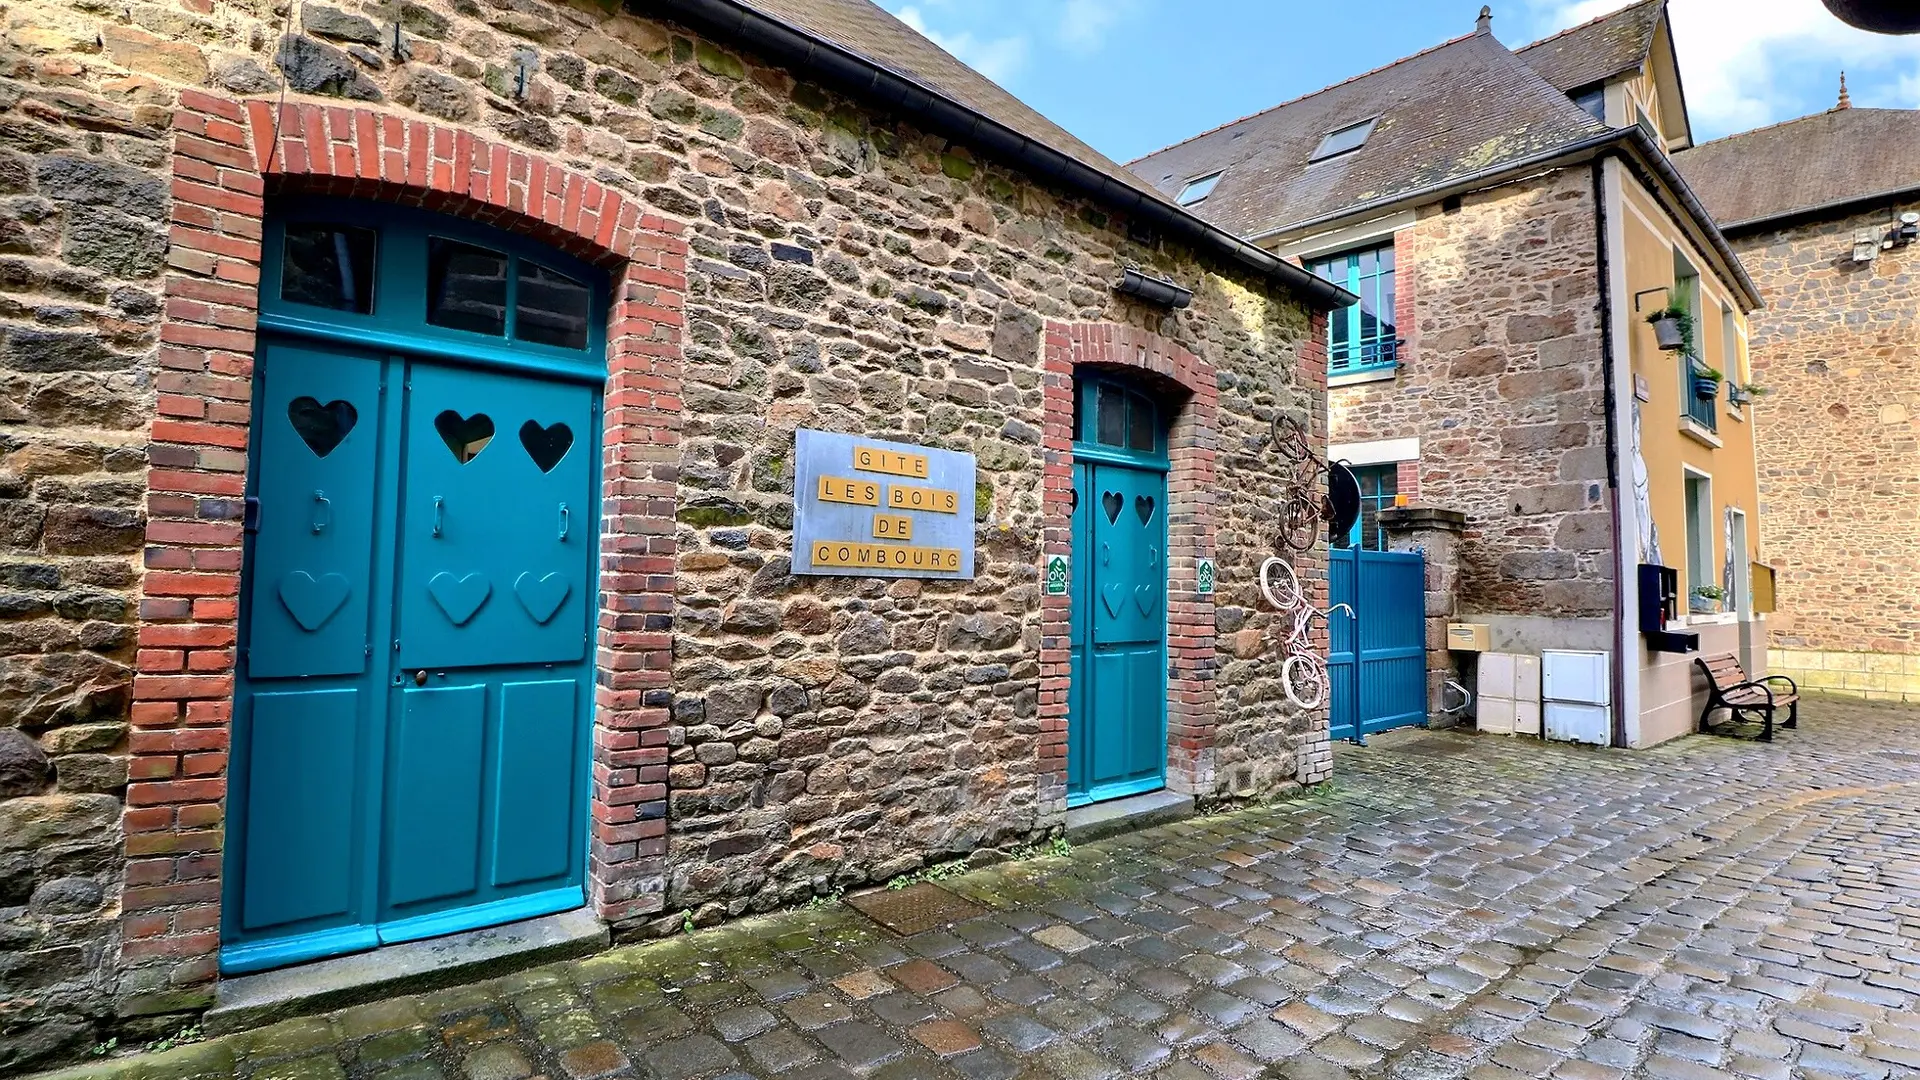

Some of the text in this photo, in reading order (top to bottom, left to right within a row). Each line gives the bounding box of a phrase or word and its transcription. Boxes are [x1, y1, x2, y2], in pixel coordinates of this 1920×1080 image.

[860, 451, 923, 473] GITE
[825, 481, 954, 509] LES BOIS
[879, 519, 907, 535] DE
[818, 546, 957, 567] COMBOURG
